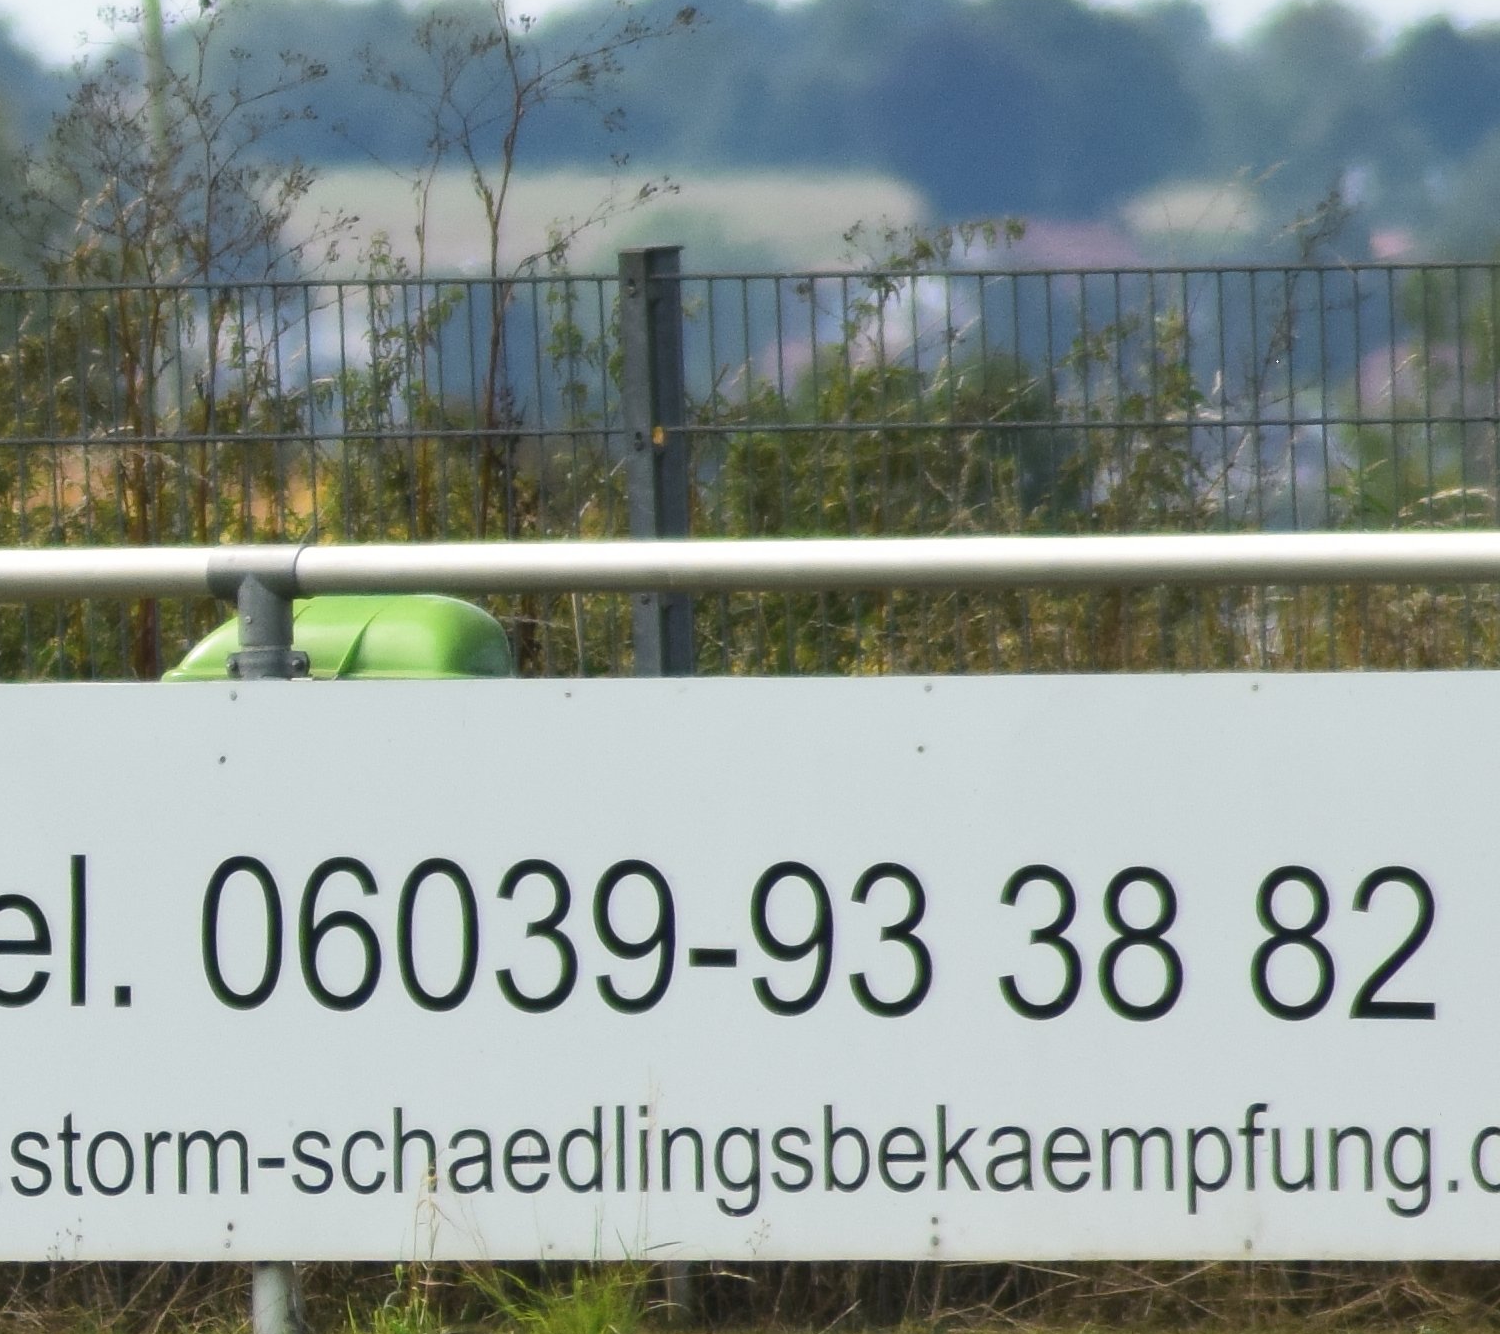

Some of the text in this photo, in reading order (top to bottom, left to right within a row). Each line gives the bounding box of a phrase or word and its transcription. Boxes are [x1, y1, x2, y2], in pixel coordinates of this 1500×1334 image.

[200, 855, 933, 1018] 06039-93
[999, 864, 1184, 1023] 38
[1250, 865, 1437, 1023] 82
